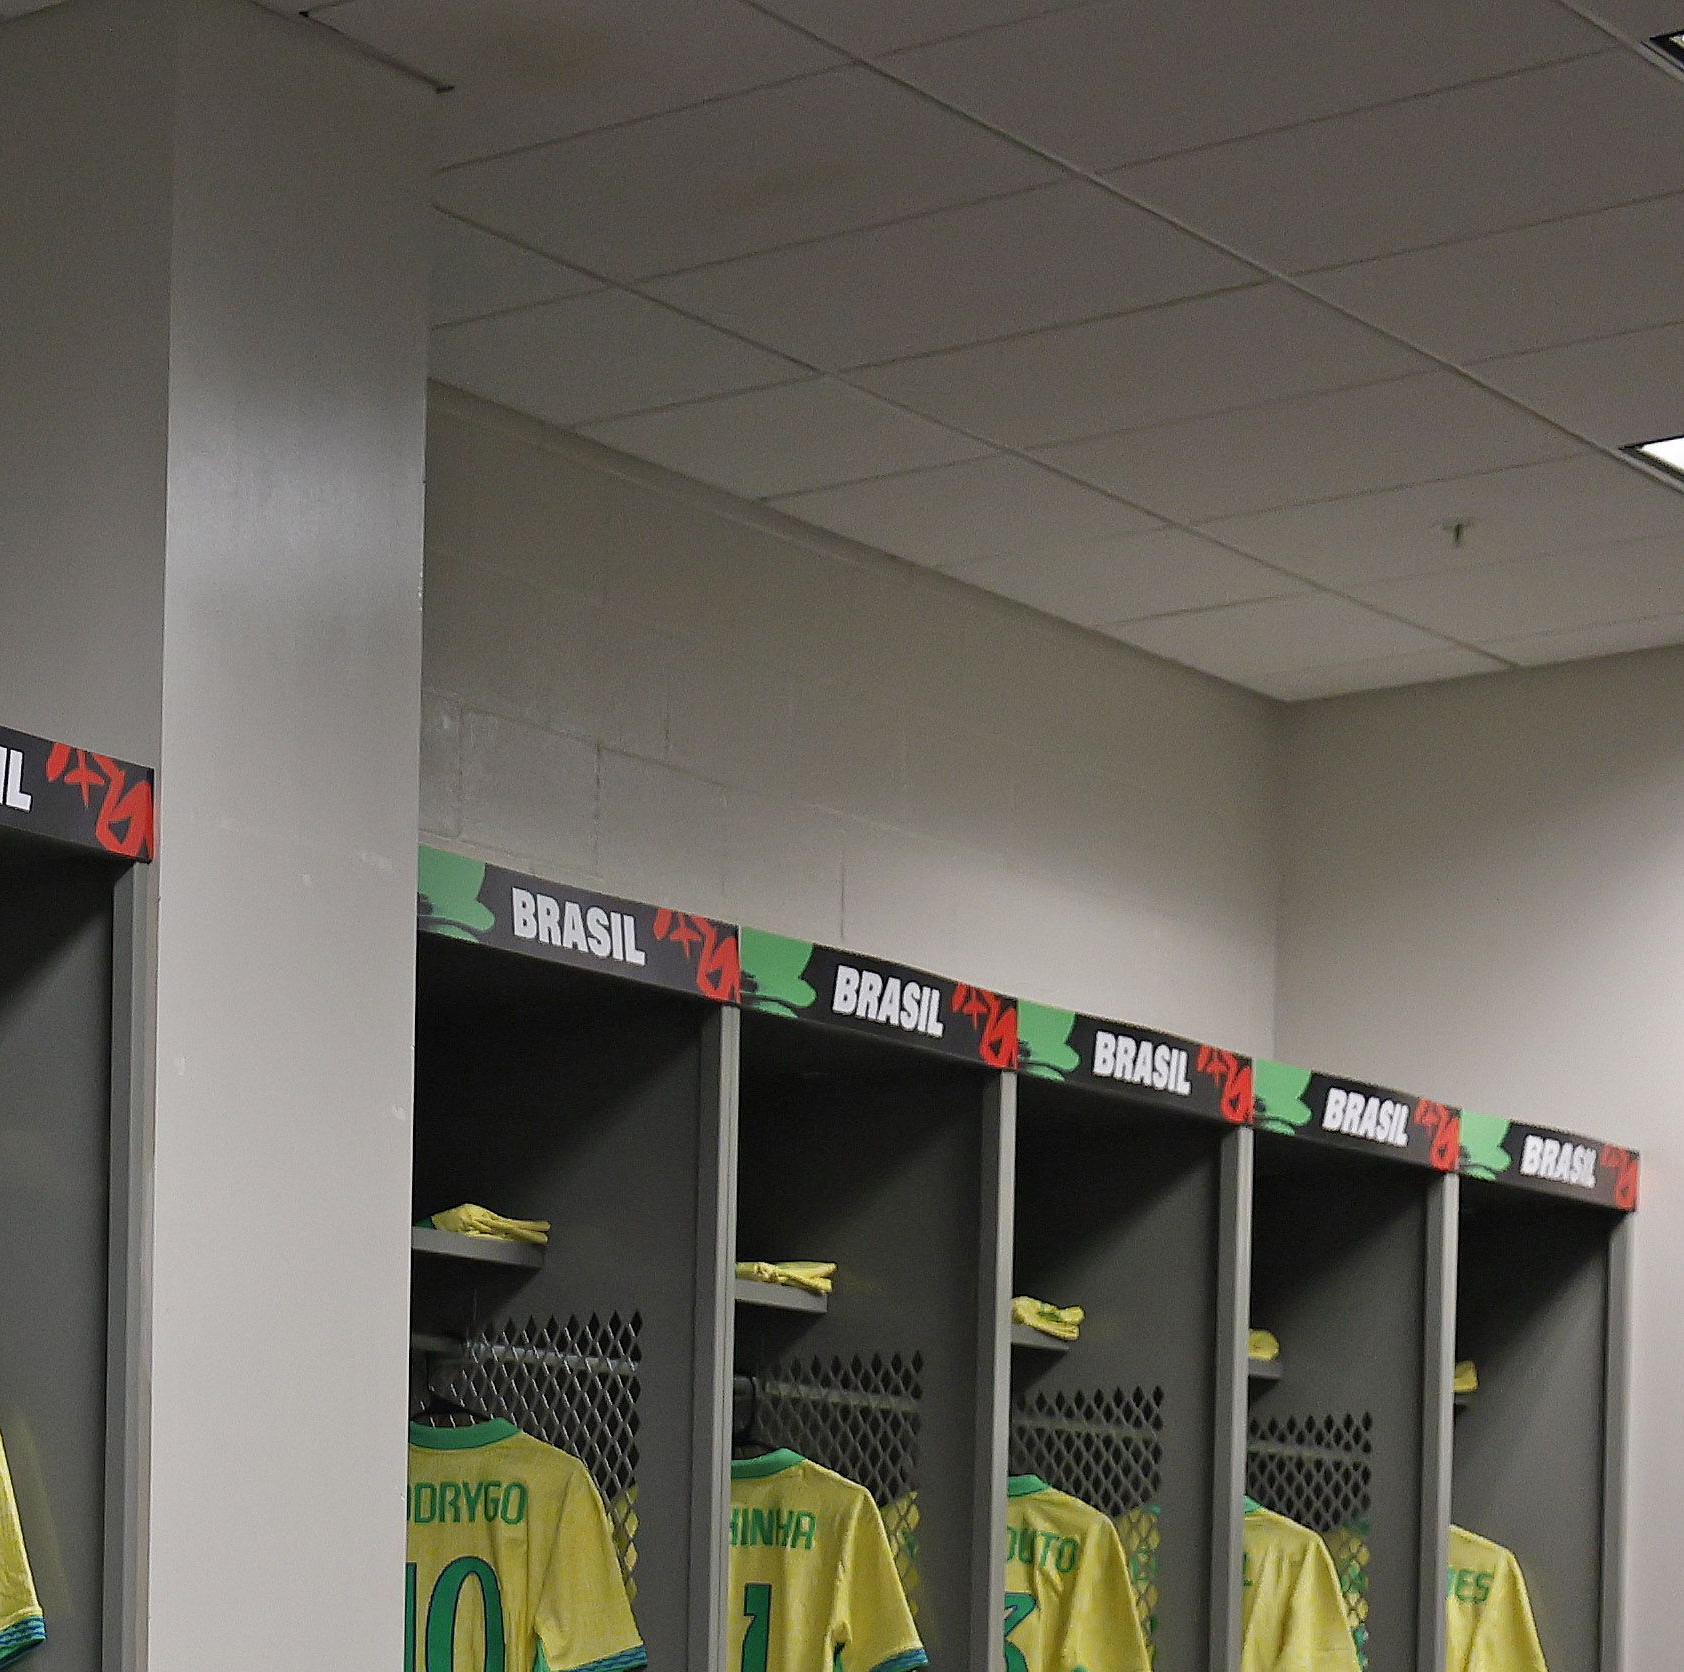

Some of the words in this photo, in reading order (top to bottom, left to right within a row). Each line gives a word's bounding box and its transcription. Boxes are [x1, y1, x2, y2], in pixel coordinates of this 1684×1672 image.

[512, 887, 646, 966] BRASIL
[832, 964, 944, 1038] BRASIL
[1093, 1030, 1191, 1096] BRASIL
[1322, 1087, 1409, 1147] BRASIL
[1521, 1134, 1597, 1189] BRASIL
